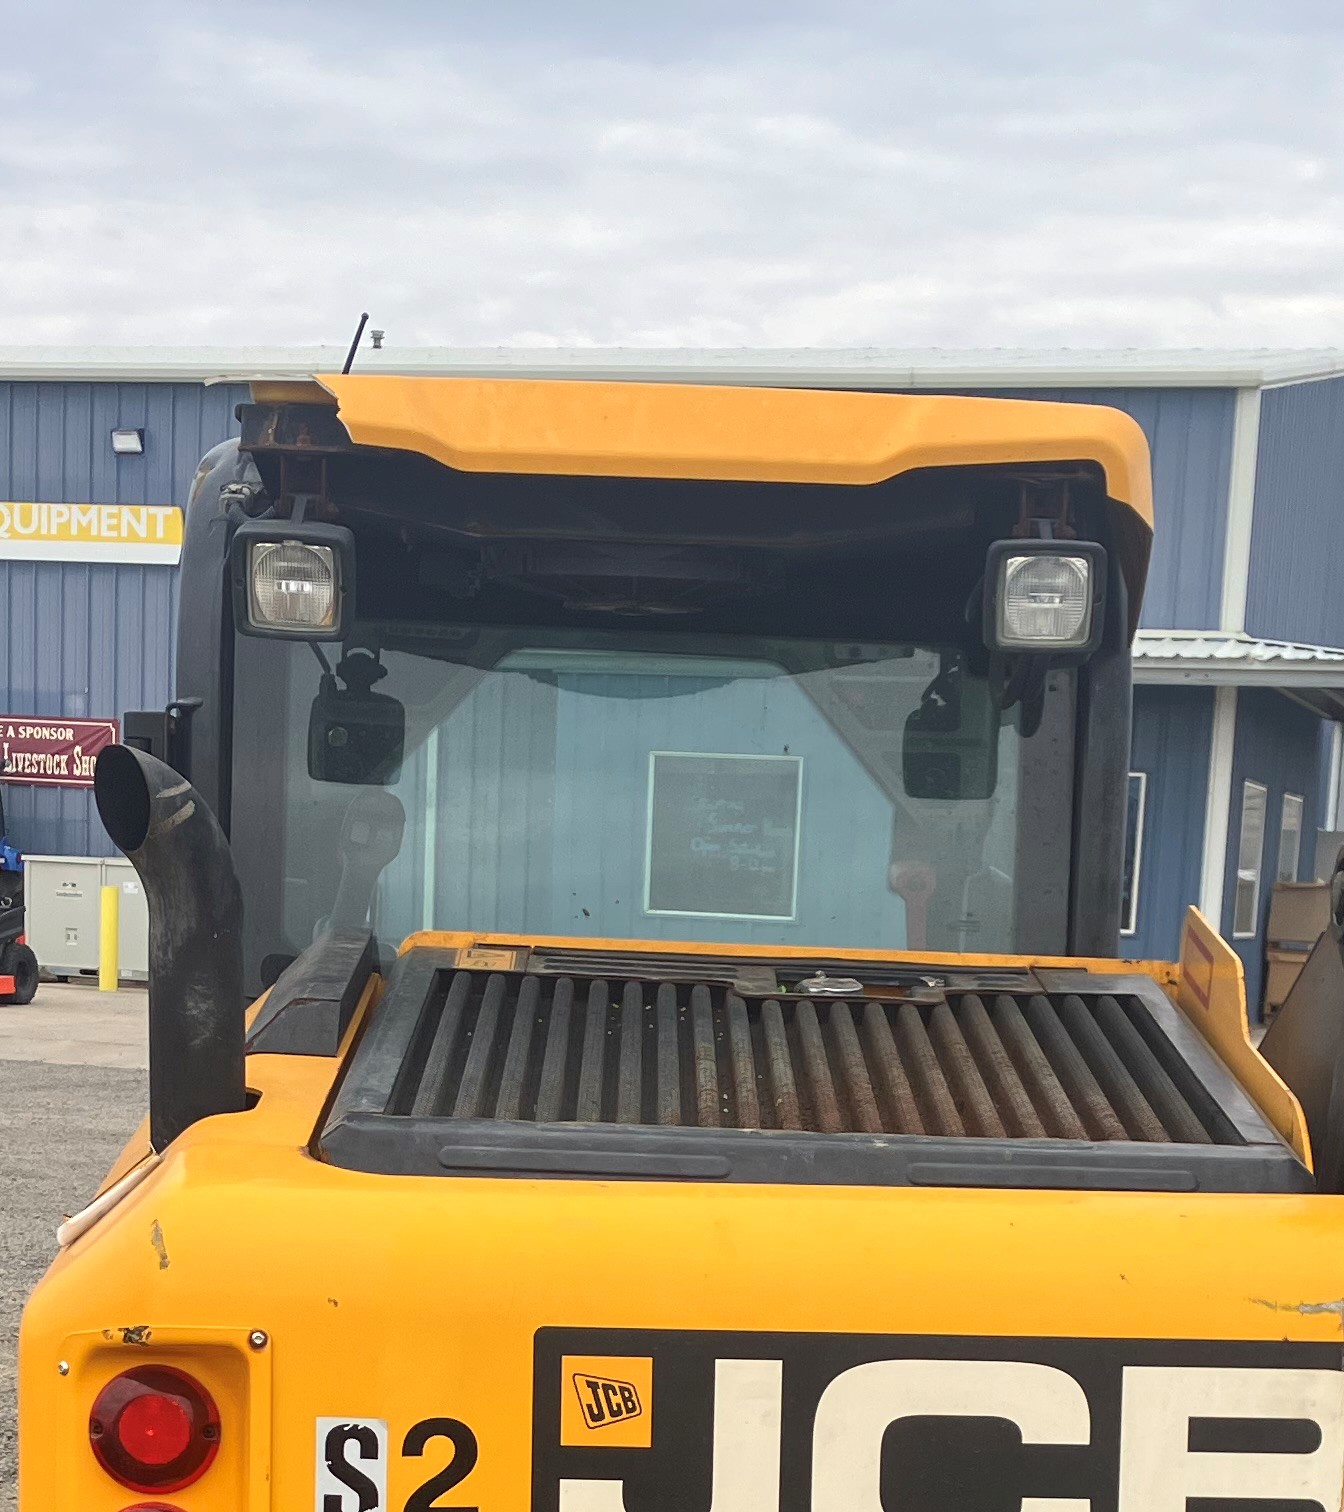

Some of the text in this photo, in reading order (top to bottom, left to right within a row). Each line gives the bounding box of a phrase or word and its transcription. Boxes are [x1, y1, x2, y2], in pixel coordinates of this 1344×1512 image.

[6, 726, 16, 739] A
[18, 726, 74, 741] SPONSOR
[2, 742, 69, 776] LIVESTOCK
[73, 745, 96, 777] SHO
[584, 1379, 637, 1422] JCB
